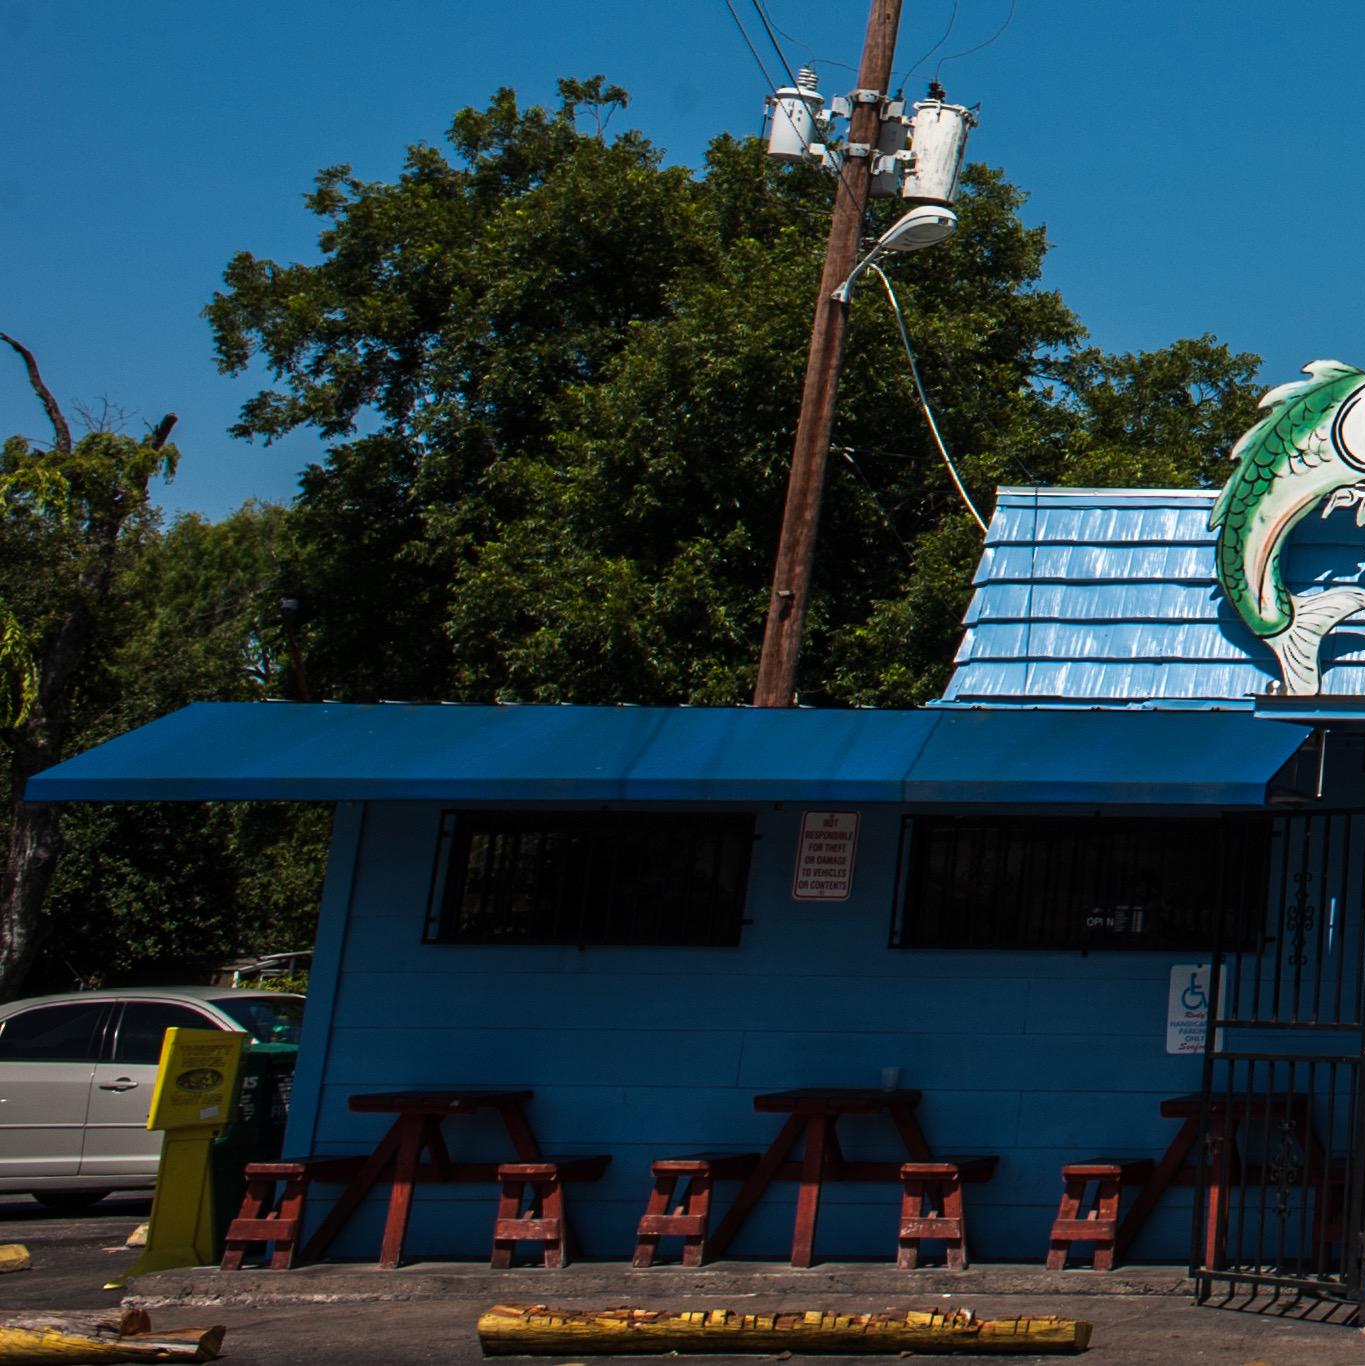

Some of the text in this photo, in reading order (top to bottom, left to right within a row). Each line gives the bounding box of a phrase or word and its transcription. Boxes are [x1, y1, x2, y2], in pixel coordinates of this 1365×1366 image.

[823, 818, 839, 827] NOT
[808, 842, 847, 852] FOR THEFT
[805, 856, 847, 864] OR DAMAGE
[802, 868, 847, 878] TO VEHICLES
[799, 880, 847, 890] OR CONTENTS
